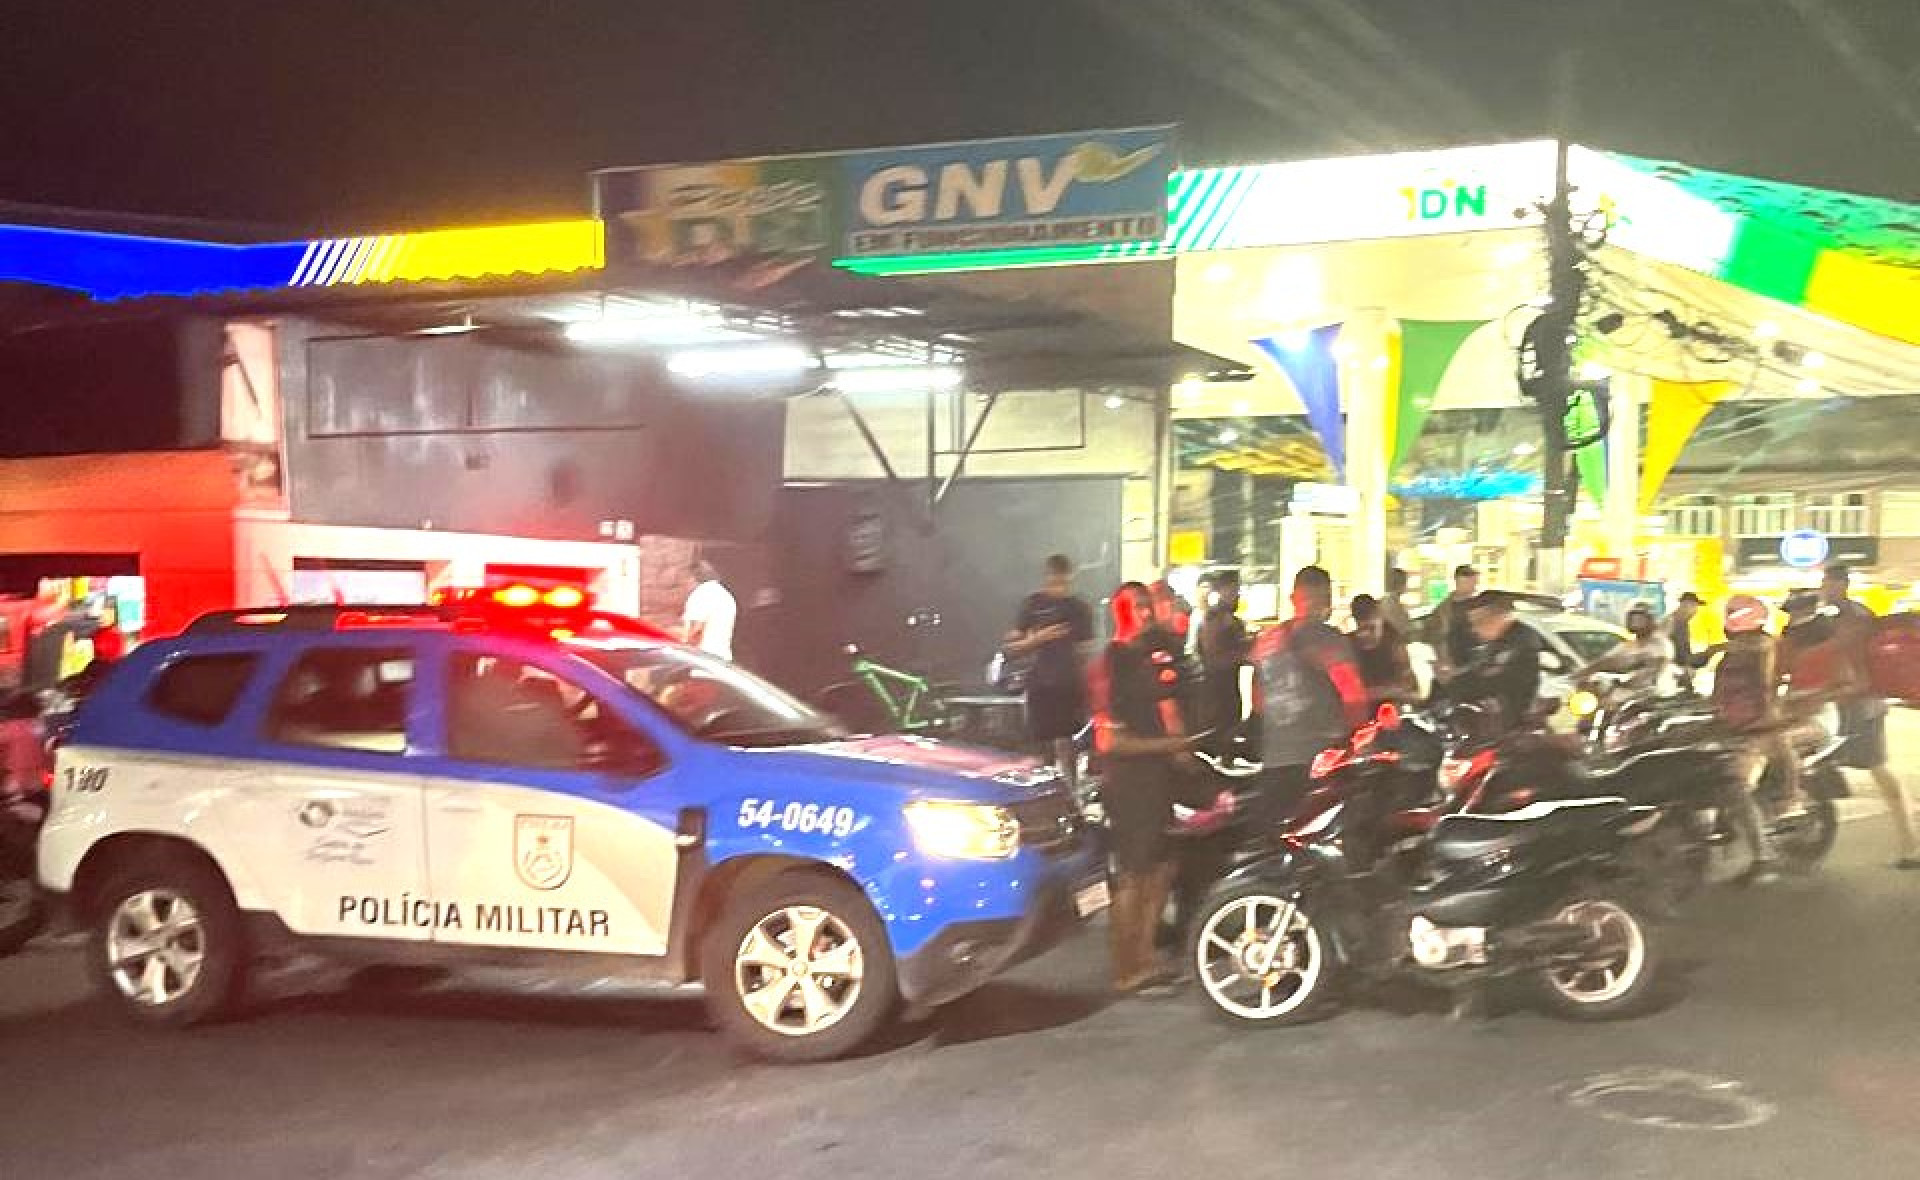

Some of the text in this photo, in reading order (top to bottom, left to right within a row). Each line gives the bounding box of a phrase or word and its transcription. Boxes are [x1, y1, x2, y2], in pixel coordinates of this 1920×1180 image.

[859, 150, 1078, 226] GNV
[737, 798, 854, 836] 54-0649
[339, 892, 610, 936] POLÍCIA MILITAR
